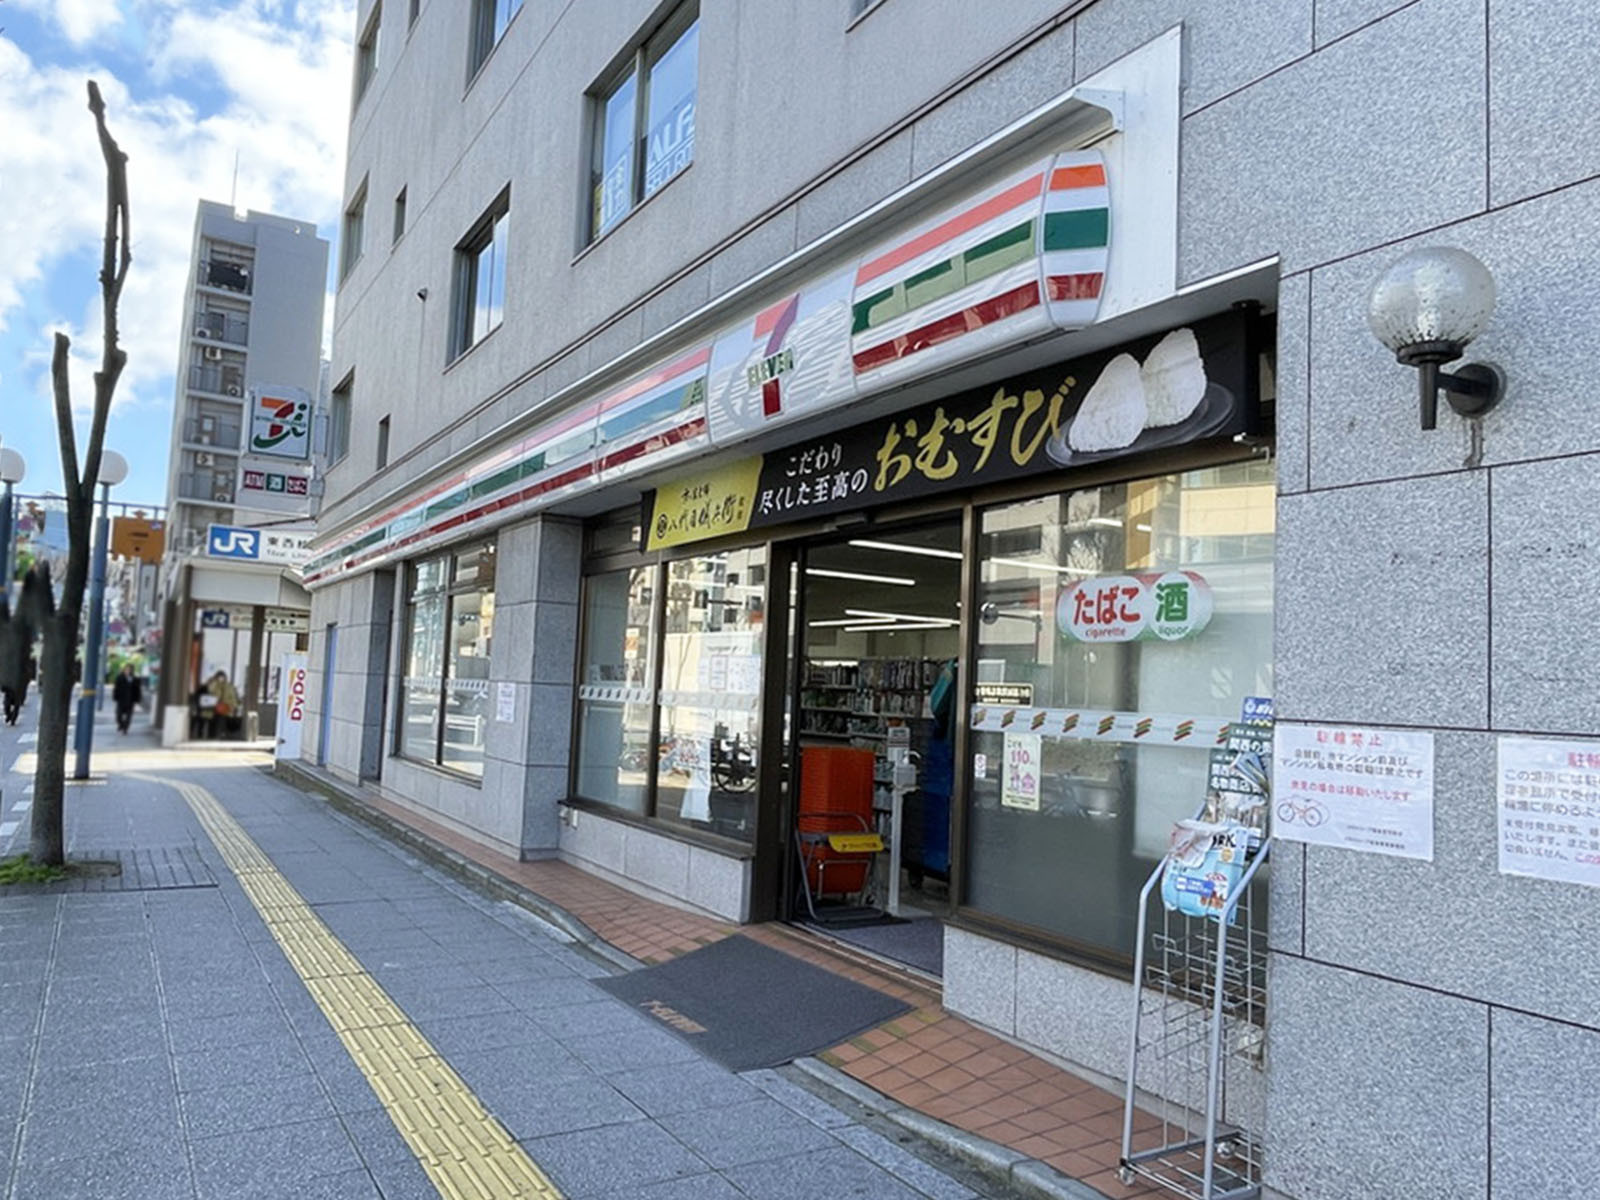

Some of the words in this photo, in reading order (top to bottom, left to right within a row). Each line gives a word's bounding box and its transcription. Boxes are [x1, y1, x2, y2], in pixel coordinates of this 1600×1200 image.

[874, 376, 1076, 491] おむすび
[786, 442, 842, 477] こだわり
[760, 468, 868, 514] 尽くした至高の
[214, 532, 255, 554] JR
[1074, 586, 1140, 625] たばこ
[1156, 582, 1189, 622] 酒
[1085, 626, 1126, 638] cigarette
[1159, 625, 1189, 636] liquor
[291, 669, 306, 720] DyDo
[1505, 769, 1600, 786] この場所には駐
